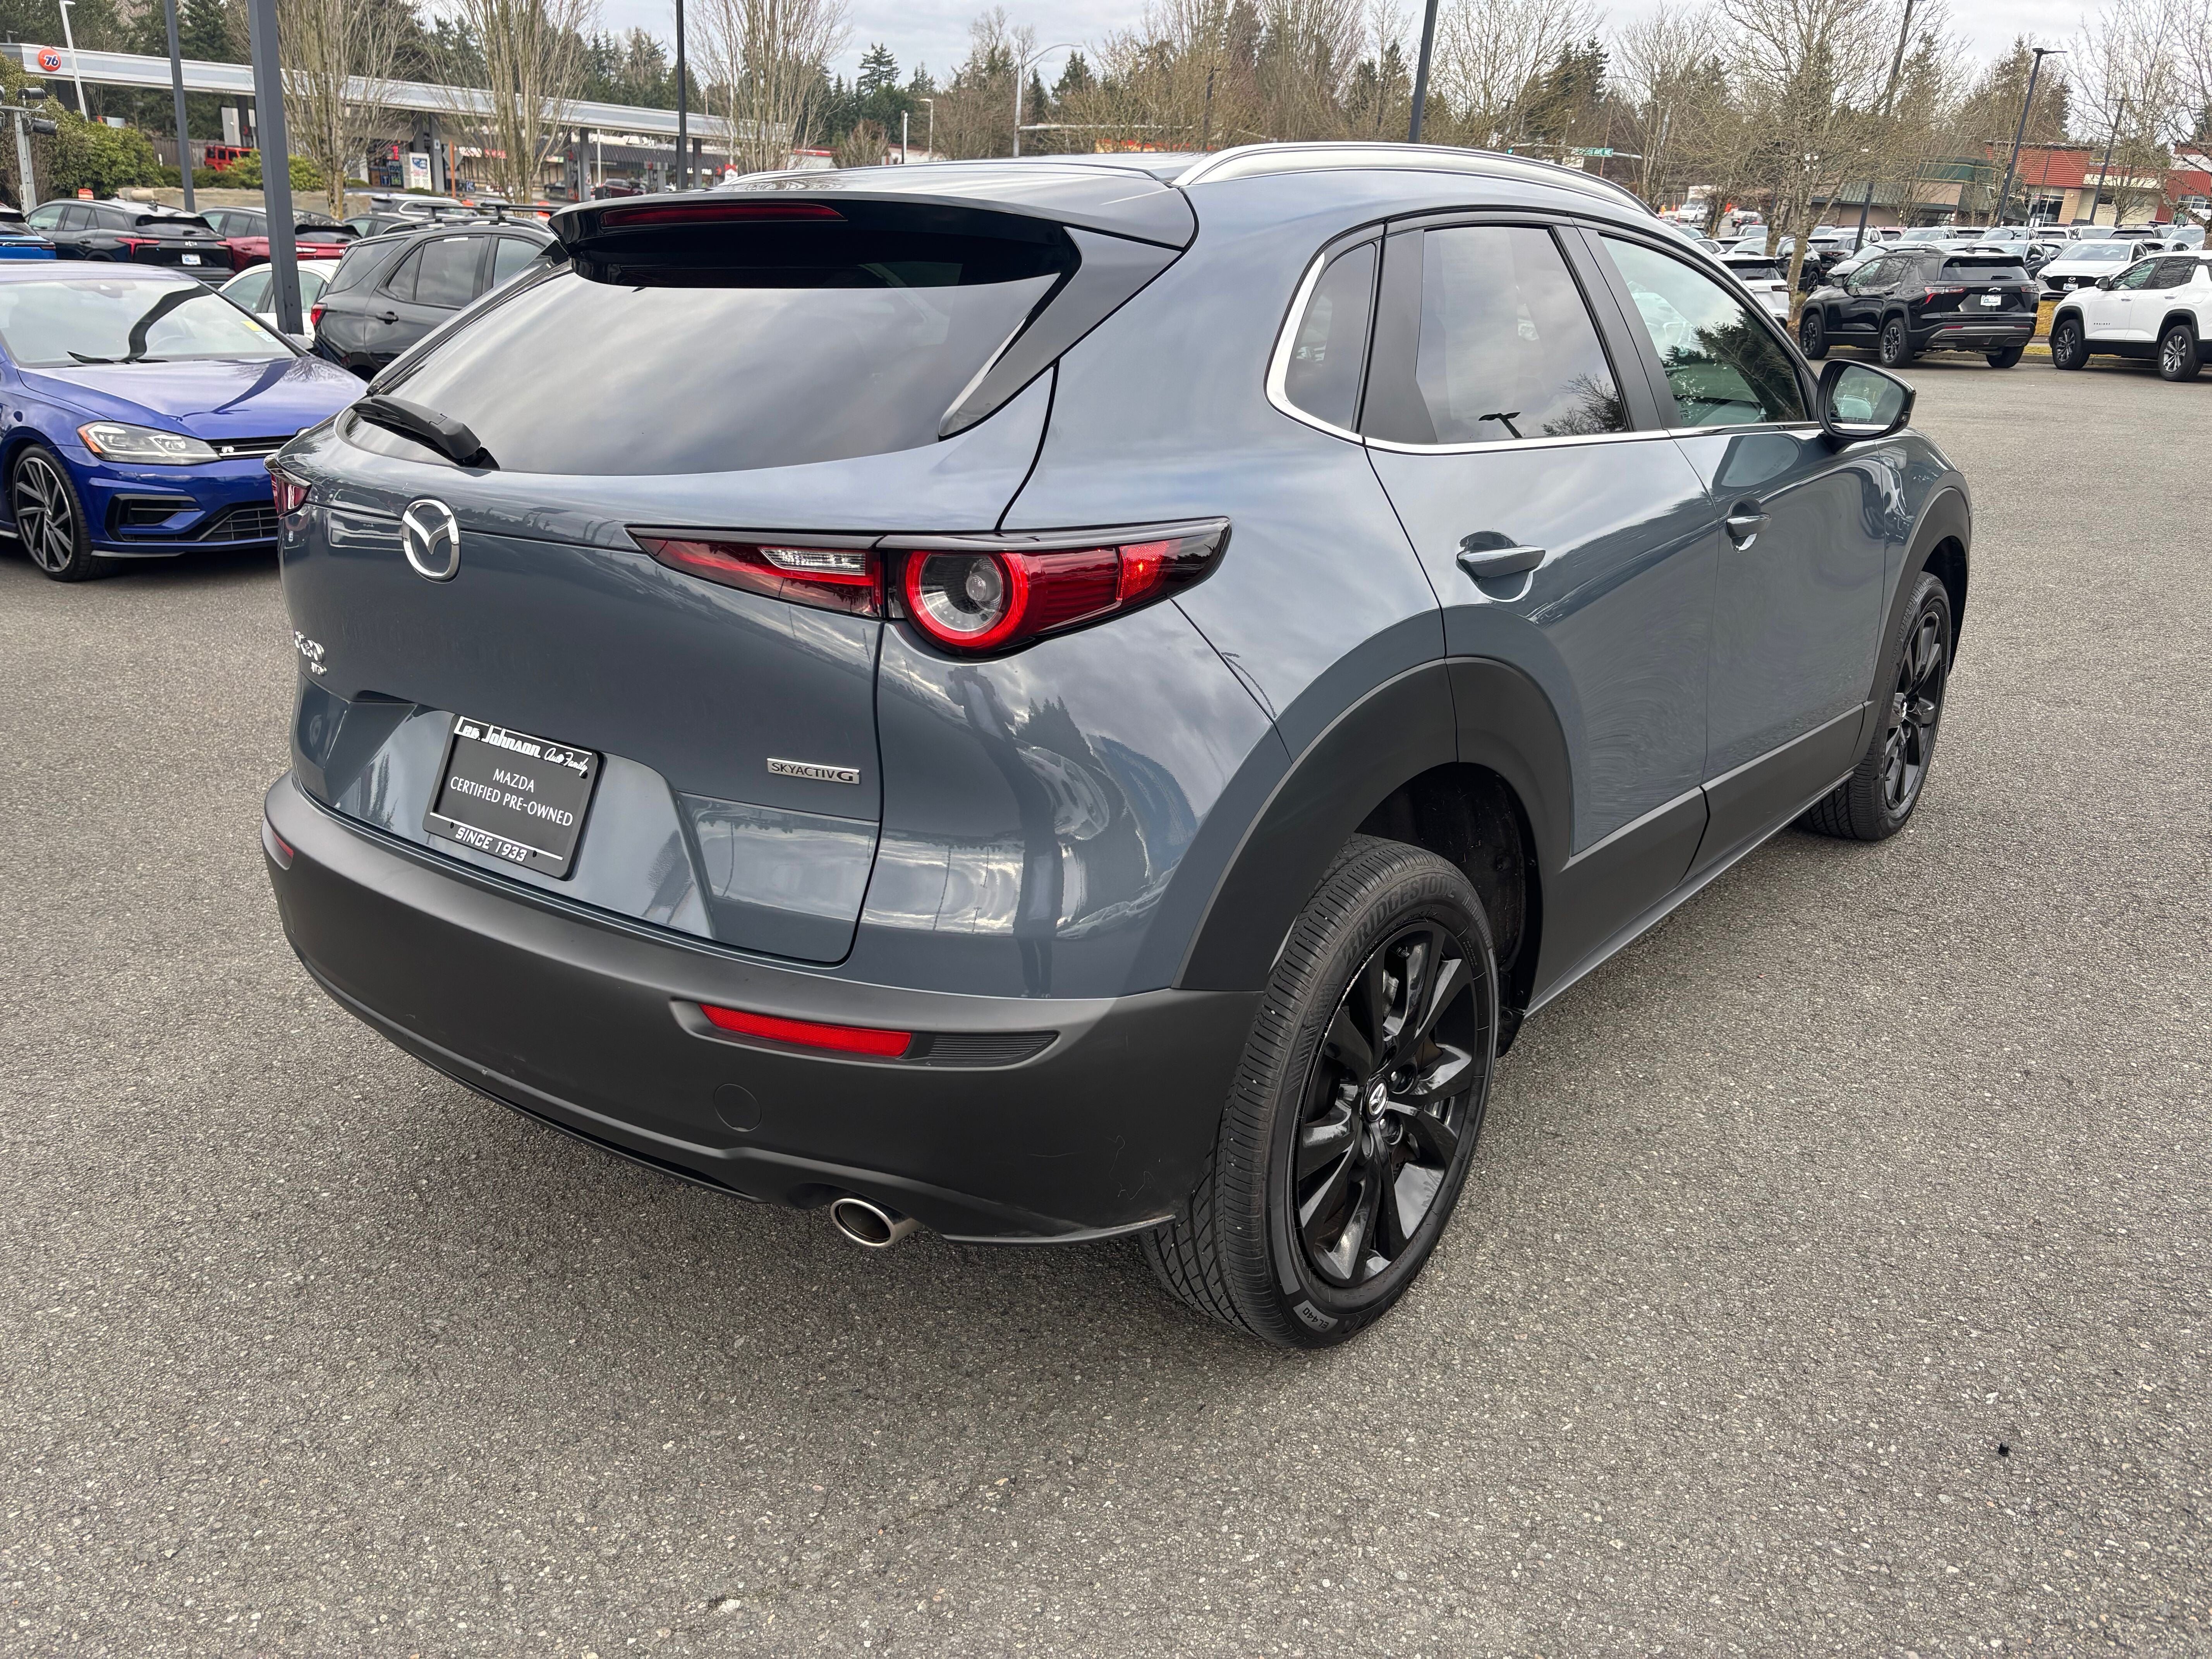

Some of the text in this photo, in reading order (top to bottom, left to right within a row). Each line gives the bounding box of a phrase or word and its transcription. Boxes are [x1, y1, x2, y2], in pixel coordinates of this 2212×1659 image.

[43, 55, 59, 67] 76
[481, 725, 541, 758] Johnson
[563, 752, 589, 776] Family
[493, 768, 534, 793] MAZDA
[450, 776, 573, 826] CERTIFIED PRE-OWNED
[455, 827, 527, 862] SINCE 1933
[1302, 1307, 1329, 1329] EL440
